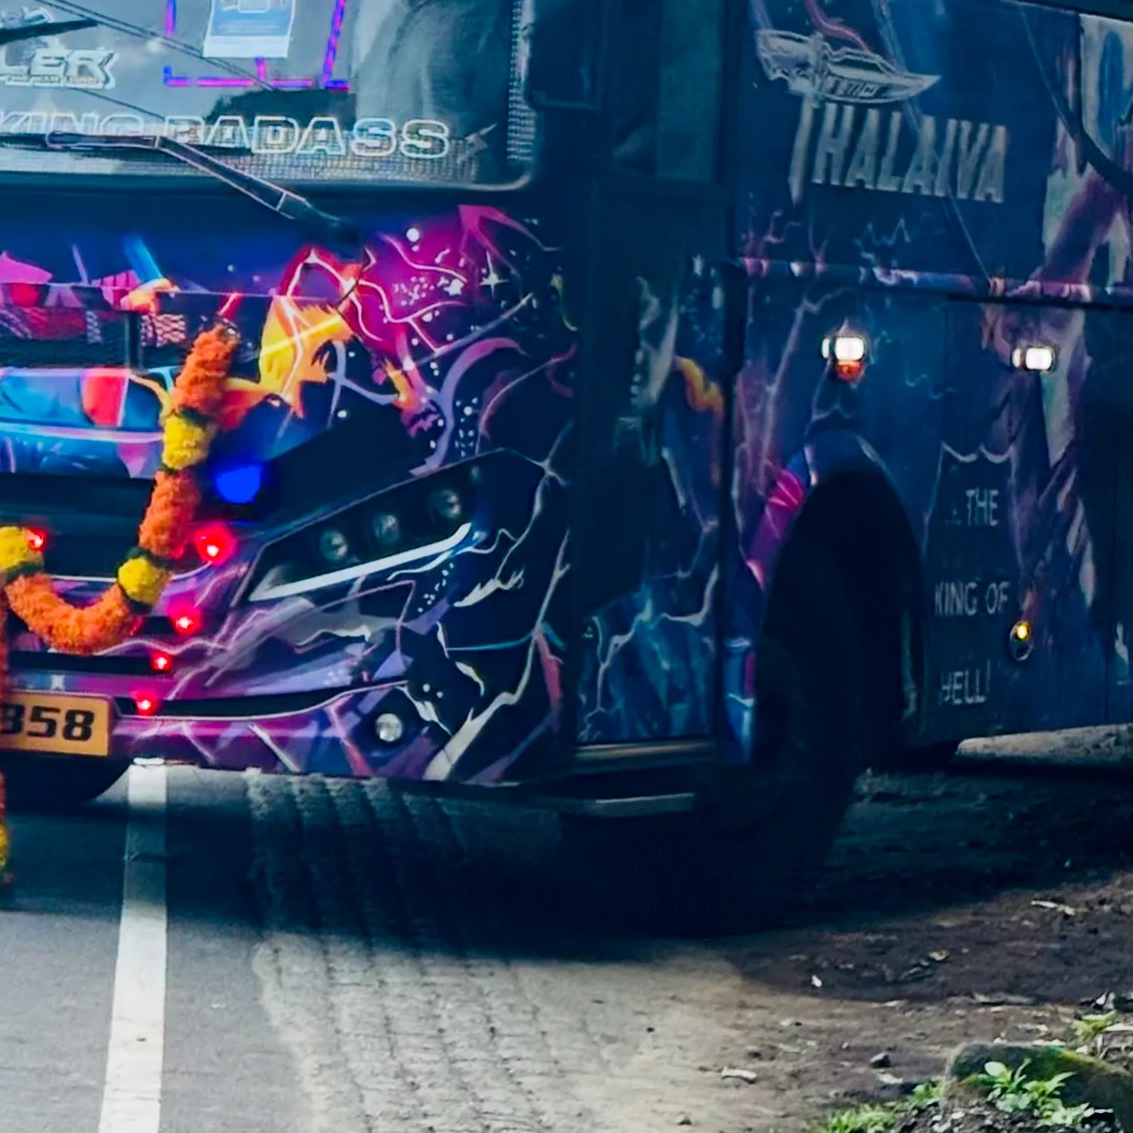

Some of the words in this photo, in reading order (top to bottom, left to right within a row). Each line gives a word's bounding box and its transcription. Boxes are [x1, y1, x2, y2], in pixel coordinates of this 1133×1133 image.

[165, 115, 450, 159] BADASS
[934, 581, 978, 616] KING
[984, 581, 1010, 615] OF
